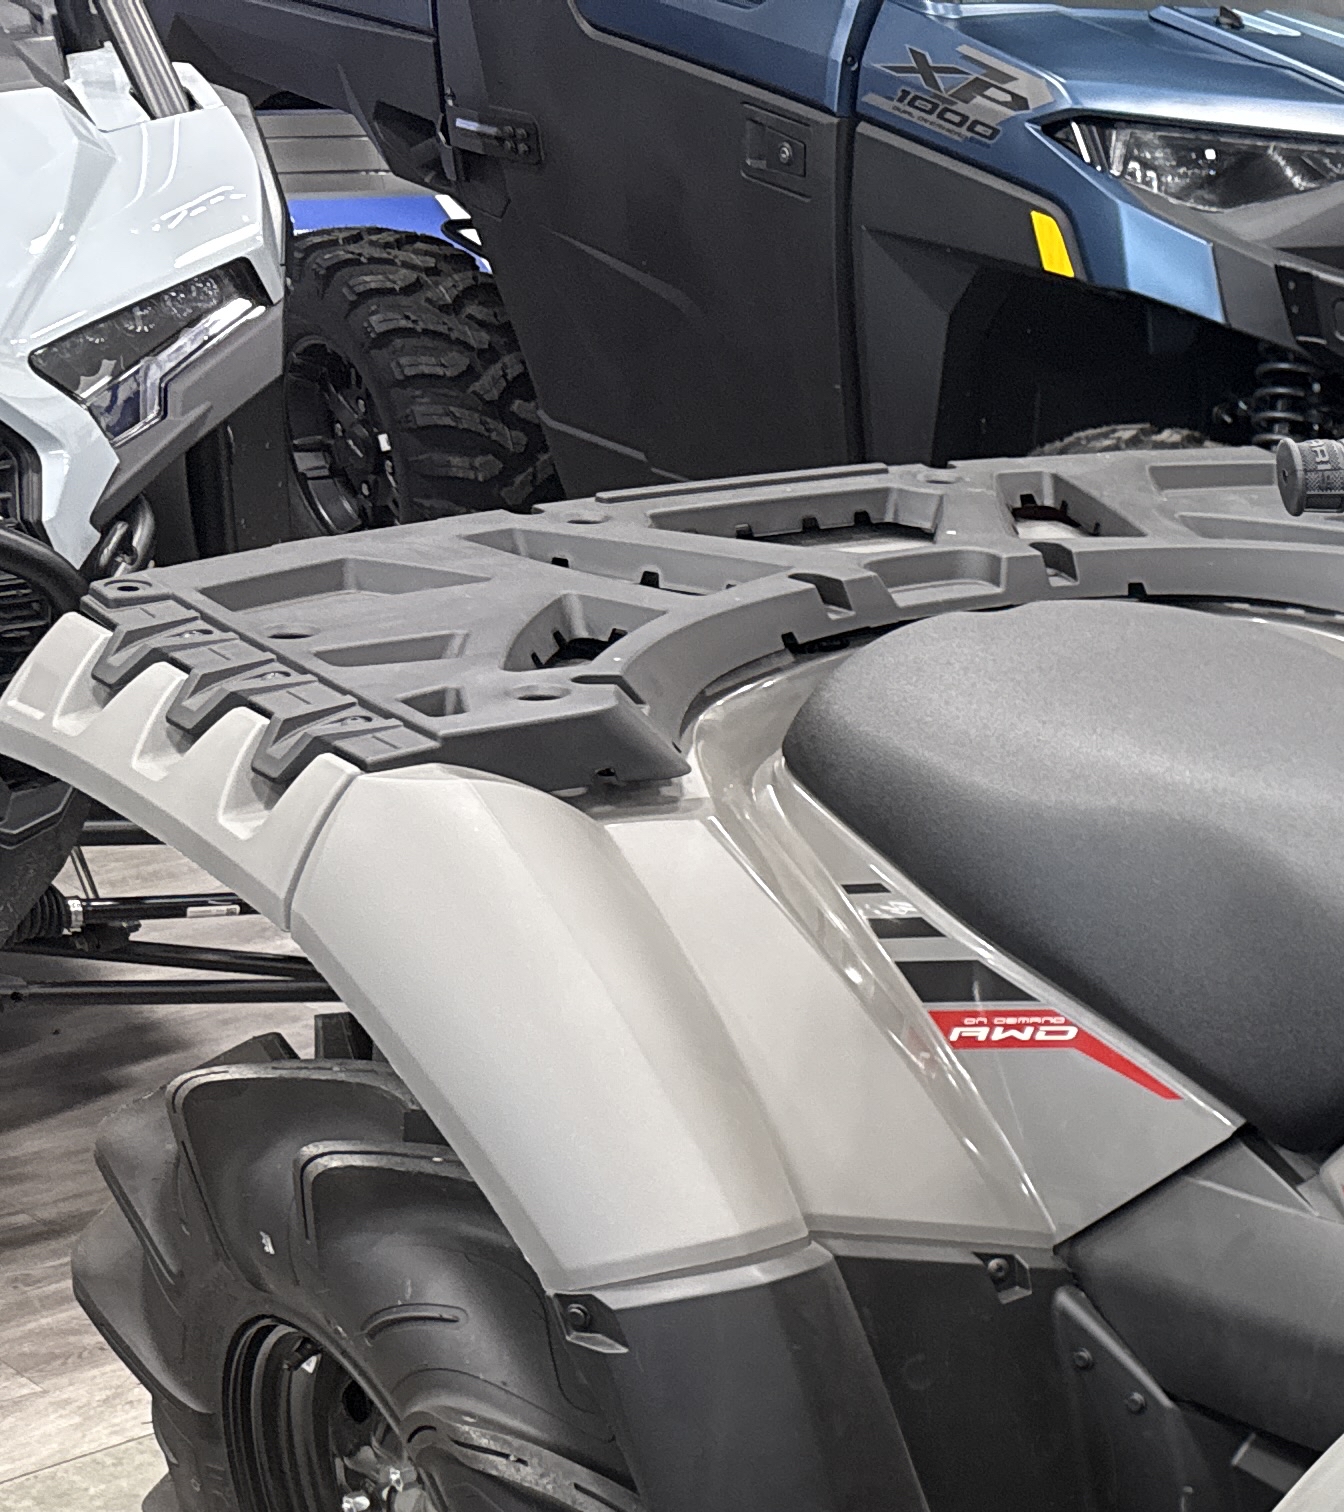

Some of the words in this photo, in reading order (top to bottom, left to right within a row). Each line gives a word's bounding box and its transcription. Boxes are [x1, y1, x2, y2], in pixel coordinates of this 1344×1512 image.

[873, 45, 1032, 113] XP
[896, 88, 1001, 141] 1000
[950, 1026, 1078, 1042] AWD
[963, 1016, 987, 1025] ON
[993, 1016, 1066, 1025] DEMAND
